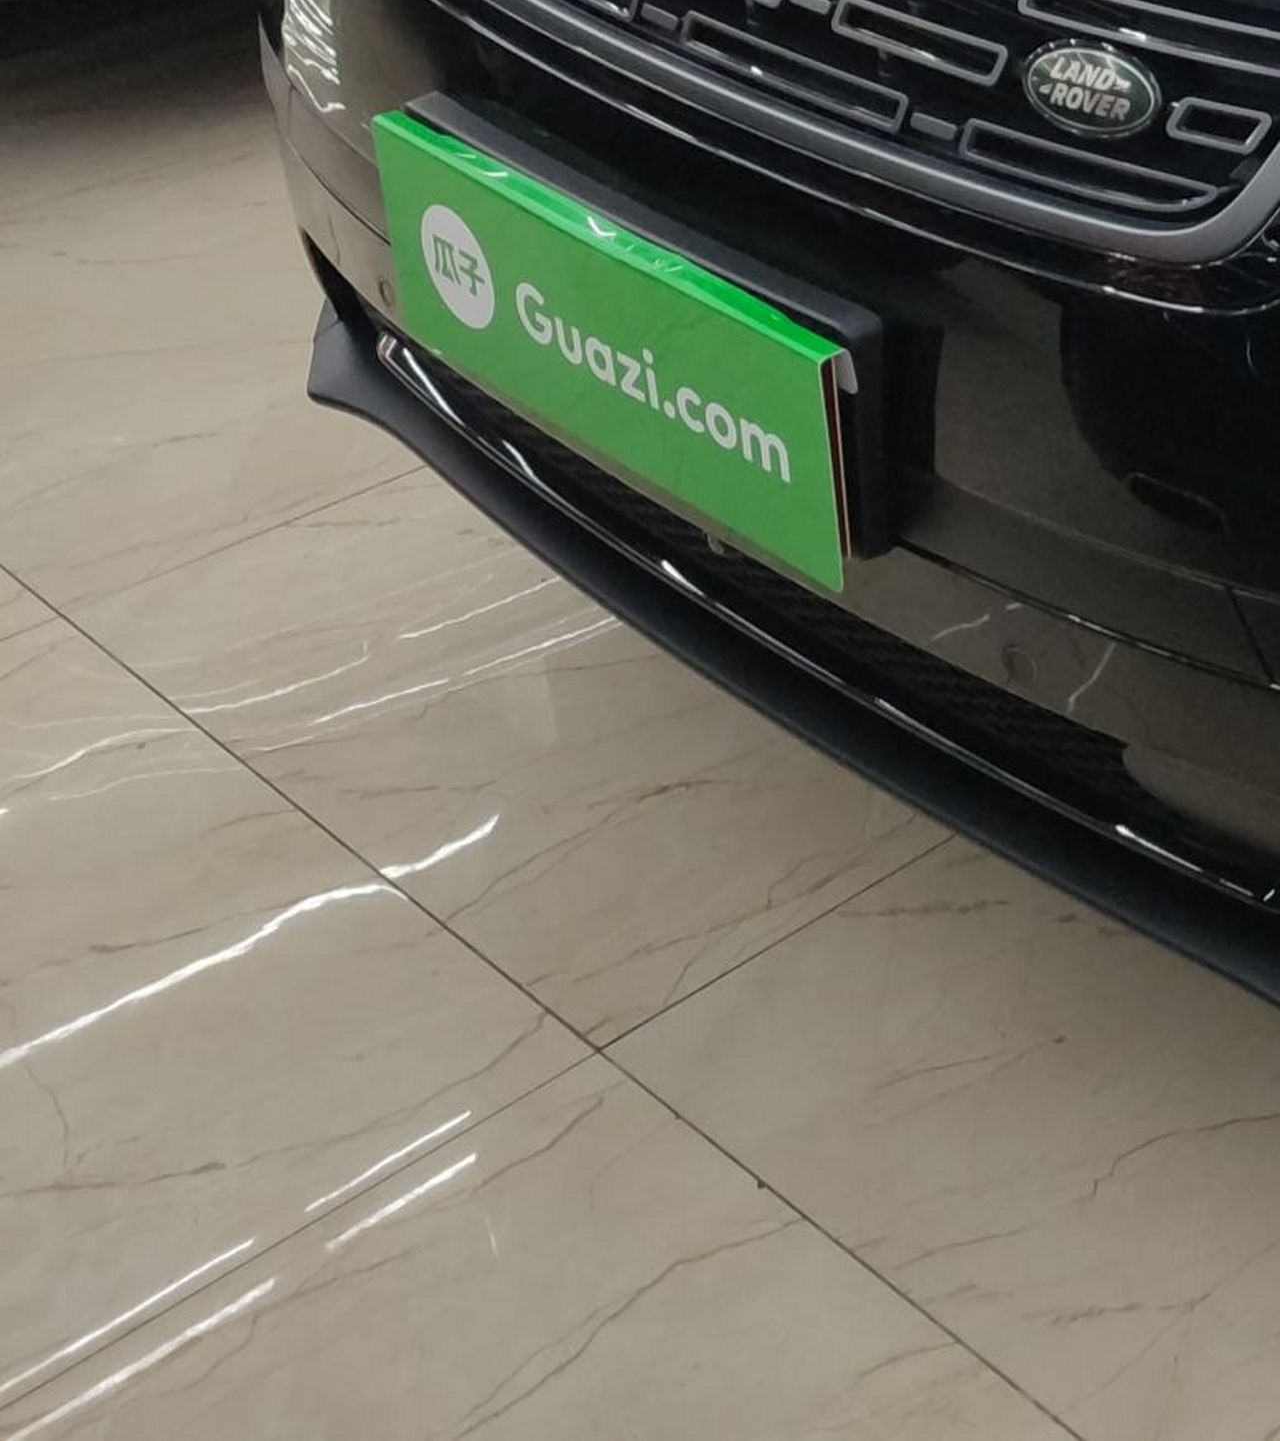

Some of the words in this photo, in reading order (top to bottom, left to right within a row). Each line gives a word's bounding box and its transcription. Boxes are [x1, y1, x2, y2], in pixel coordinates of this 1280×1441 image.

[1050, 57, 1117, 92] LAND
[1048, 82, 1131, 122] ROVER
[431, 233, 486, 296] 瓜子
[514, 281, 792, 485] Guazi.com
